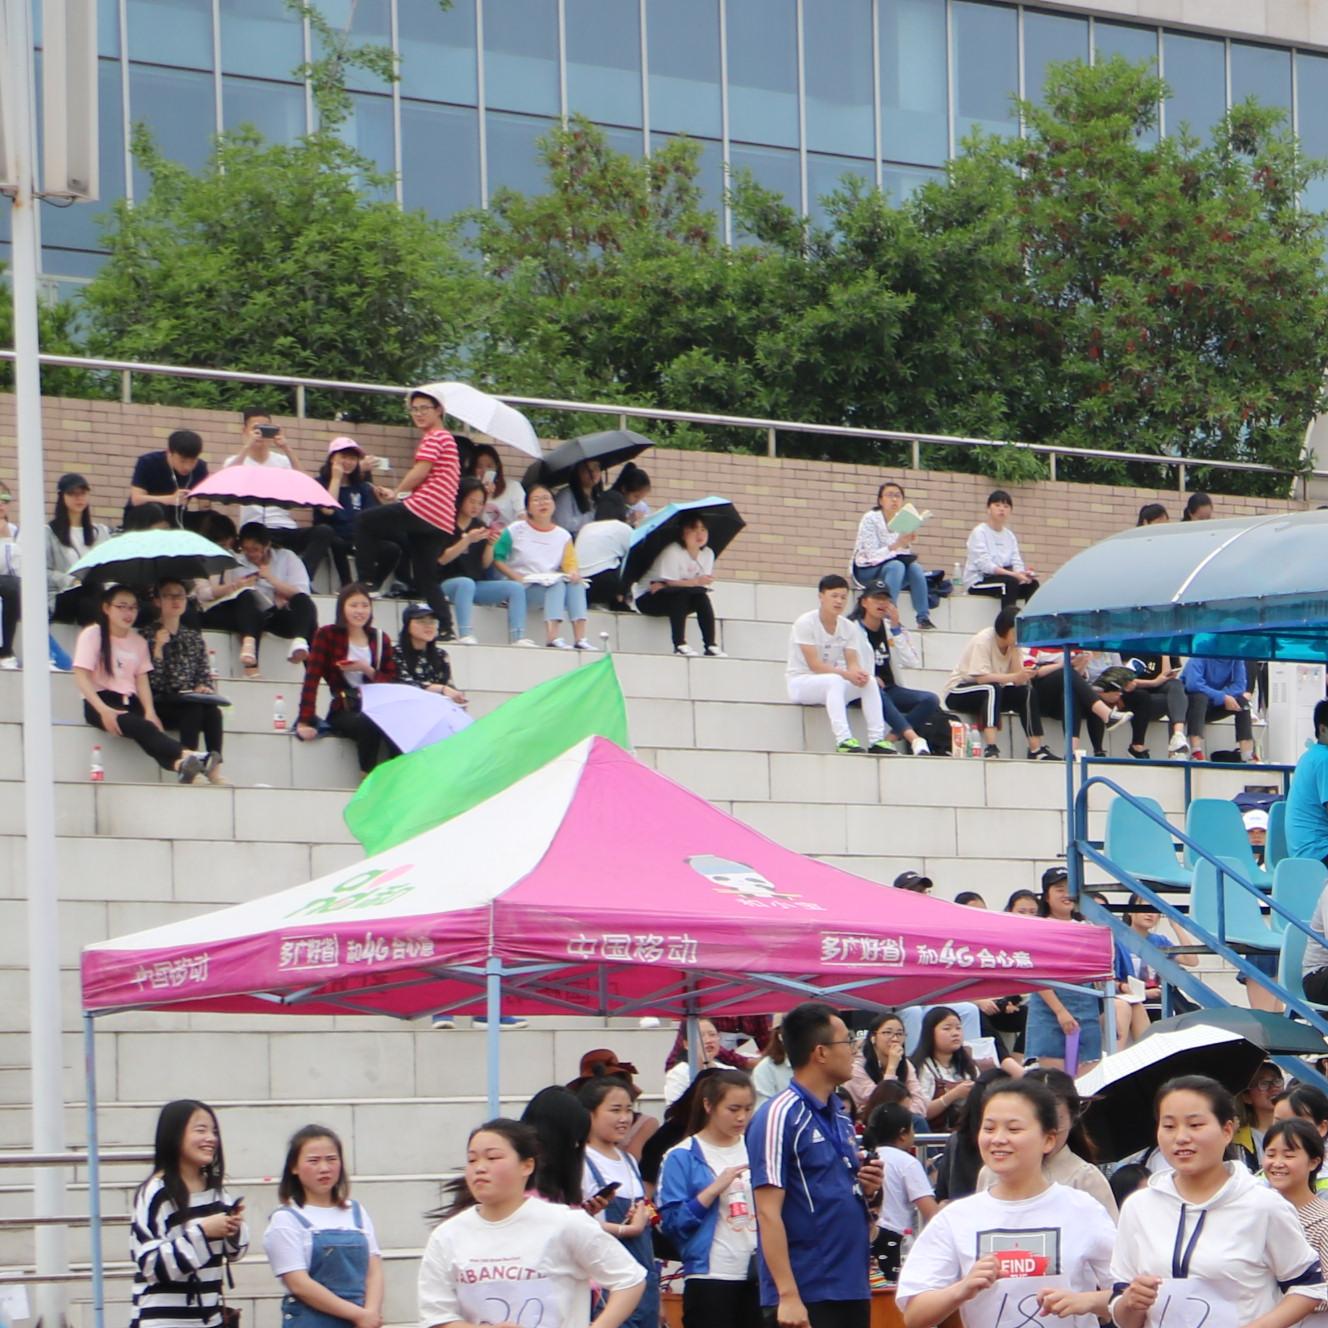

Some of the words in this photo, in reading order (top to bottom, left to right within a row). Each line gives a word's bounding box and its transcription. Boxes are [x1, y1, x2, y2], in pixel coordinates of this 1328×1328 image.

[567, 931, 698, 964] 中国移动
[131, 953, 209, 992] 中国移动
[1001, 1258, 1036, 1273] FIND
